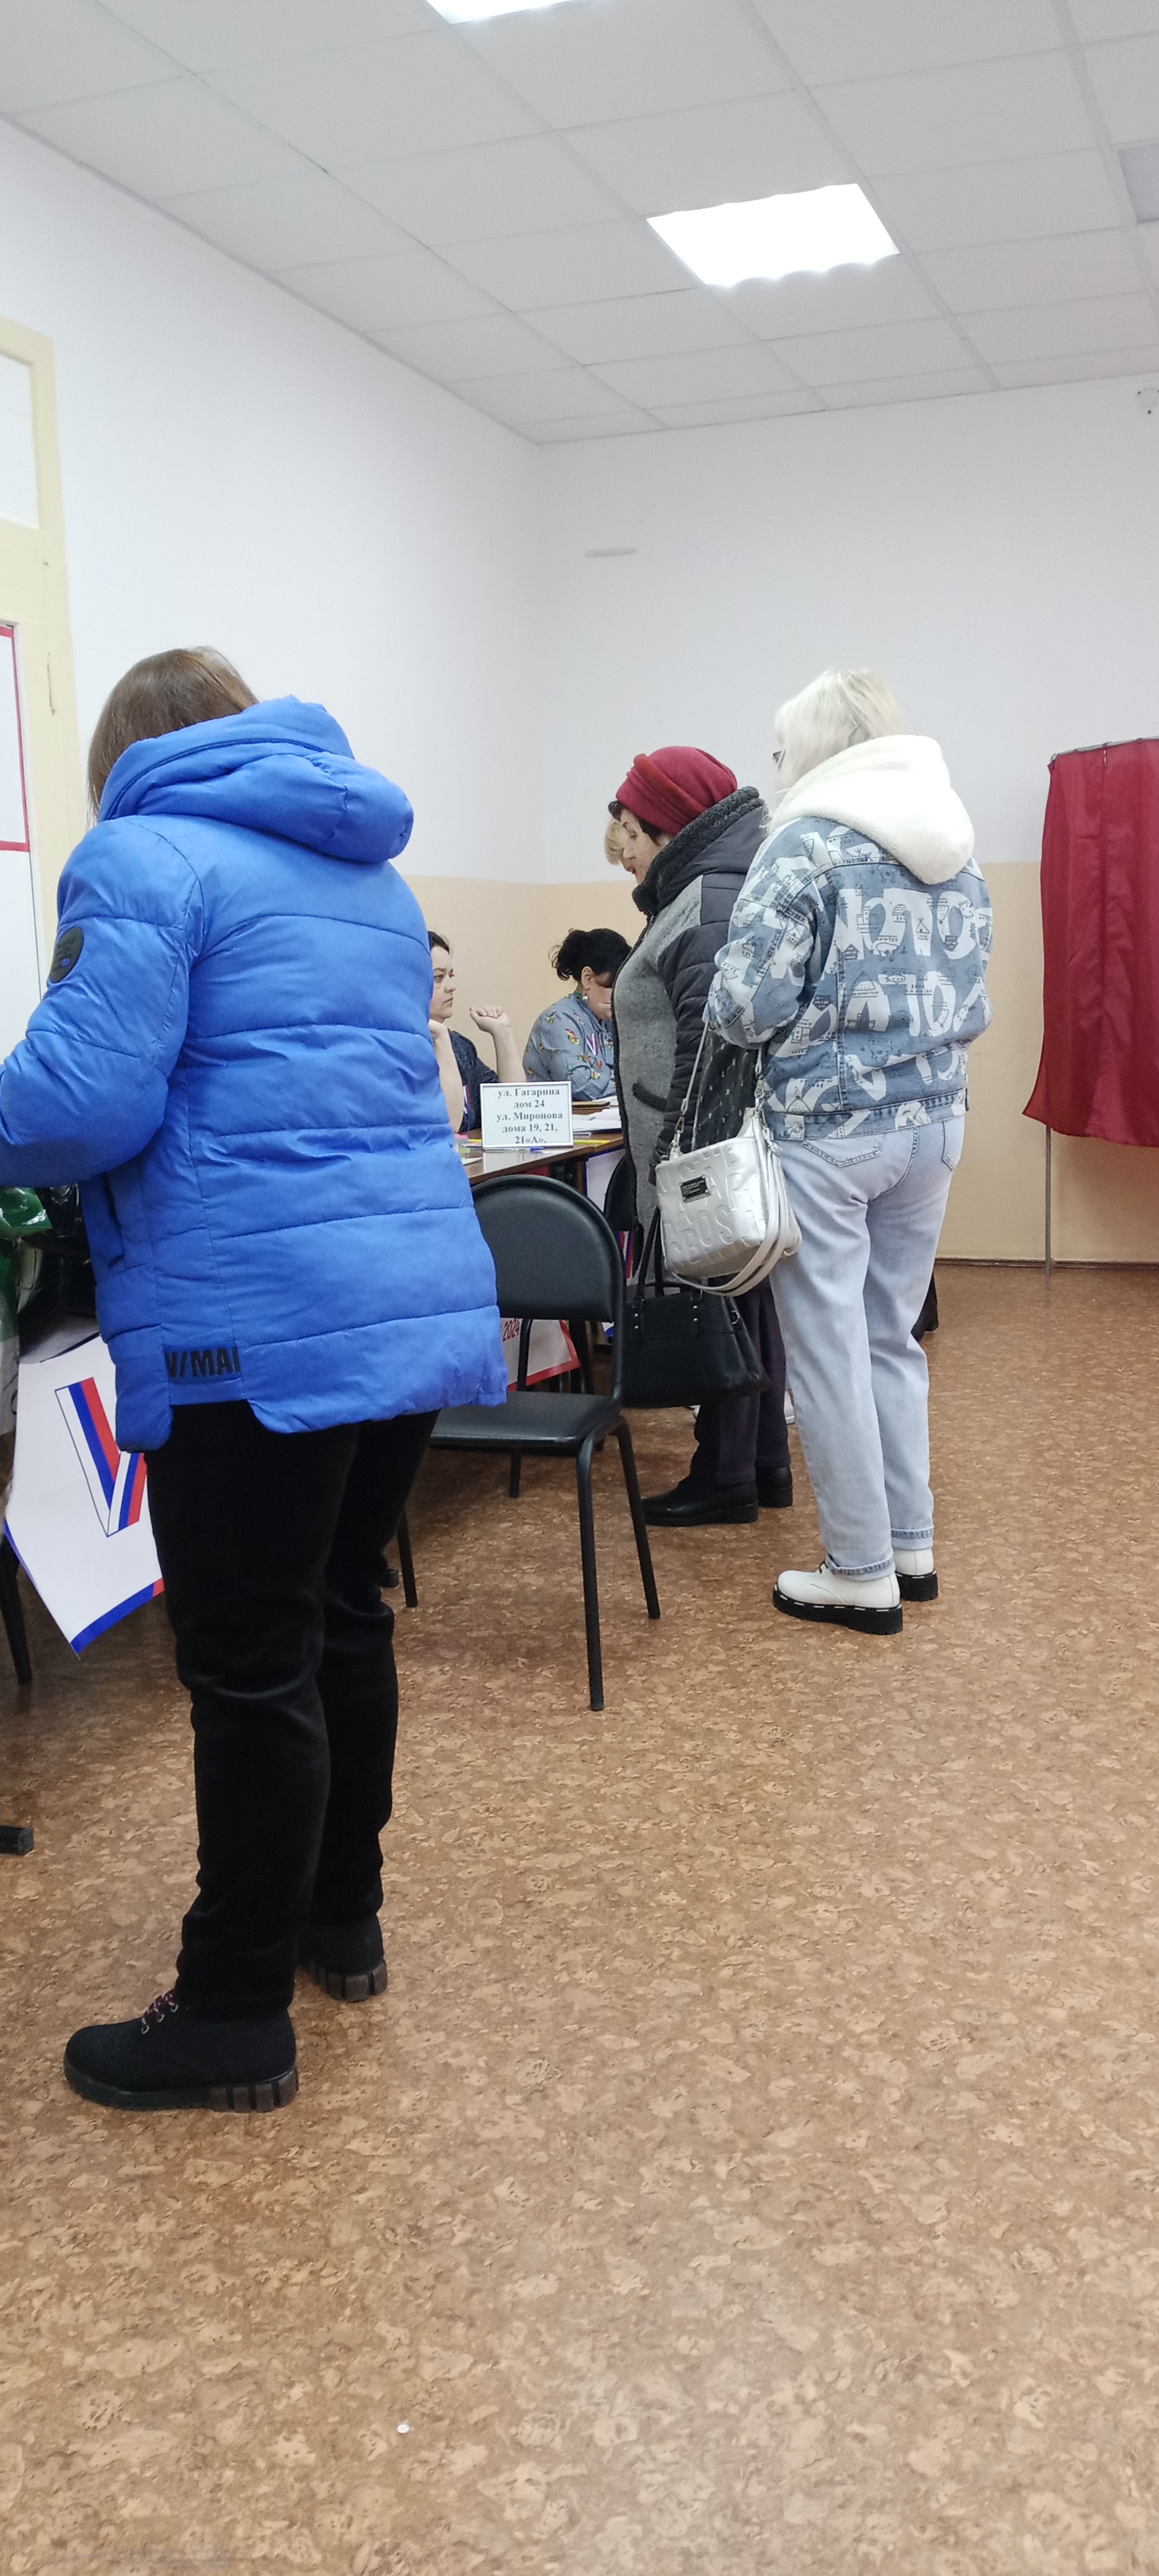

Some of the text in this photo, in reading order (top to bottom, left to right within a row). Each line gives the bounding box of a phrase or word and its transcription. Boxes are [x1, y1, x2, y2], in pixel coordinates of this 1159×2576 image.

[498, 1088, 560, 1099] ул. Гагарина
[534, 1100, 545, 1108] 24
[497, 1112, 563, 1123] ул. Миронова
[502, 1123, 558, 1133] дома 19, 21,
